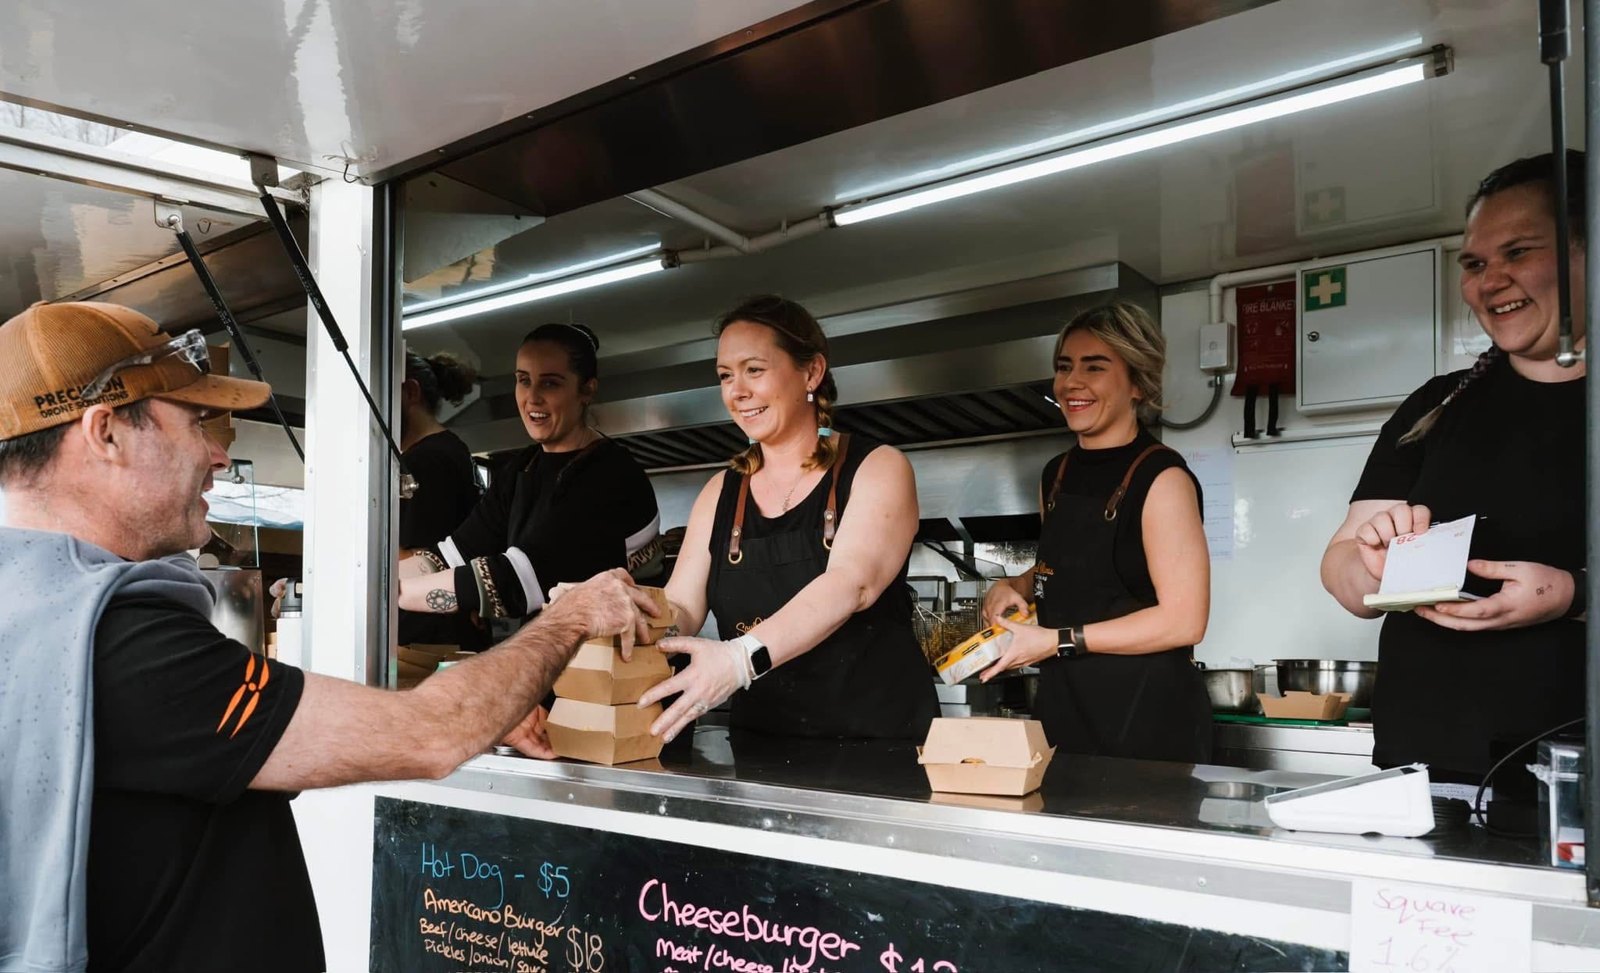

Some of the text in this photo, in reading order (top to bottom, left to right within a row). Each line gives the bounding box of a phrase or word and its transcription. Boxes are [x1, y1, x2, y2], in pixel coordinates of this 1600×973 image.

[40, 403, 74, 418] DRONE
[421, 842, 455, 878] Hot
[460, 853, 504, 909] Dog
[537, 861, 570, 898] $5
[423, 888, 565, 947] Americano Burger
[638, 879, 860, 967] Cheeseburger
[1372, 888, 1477, 924] Square
[565, 924, 604, 973] $18
[1415, 918, 1474, 946] Fee
